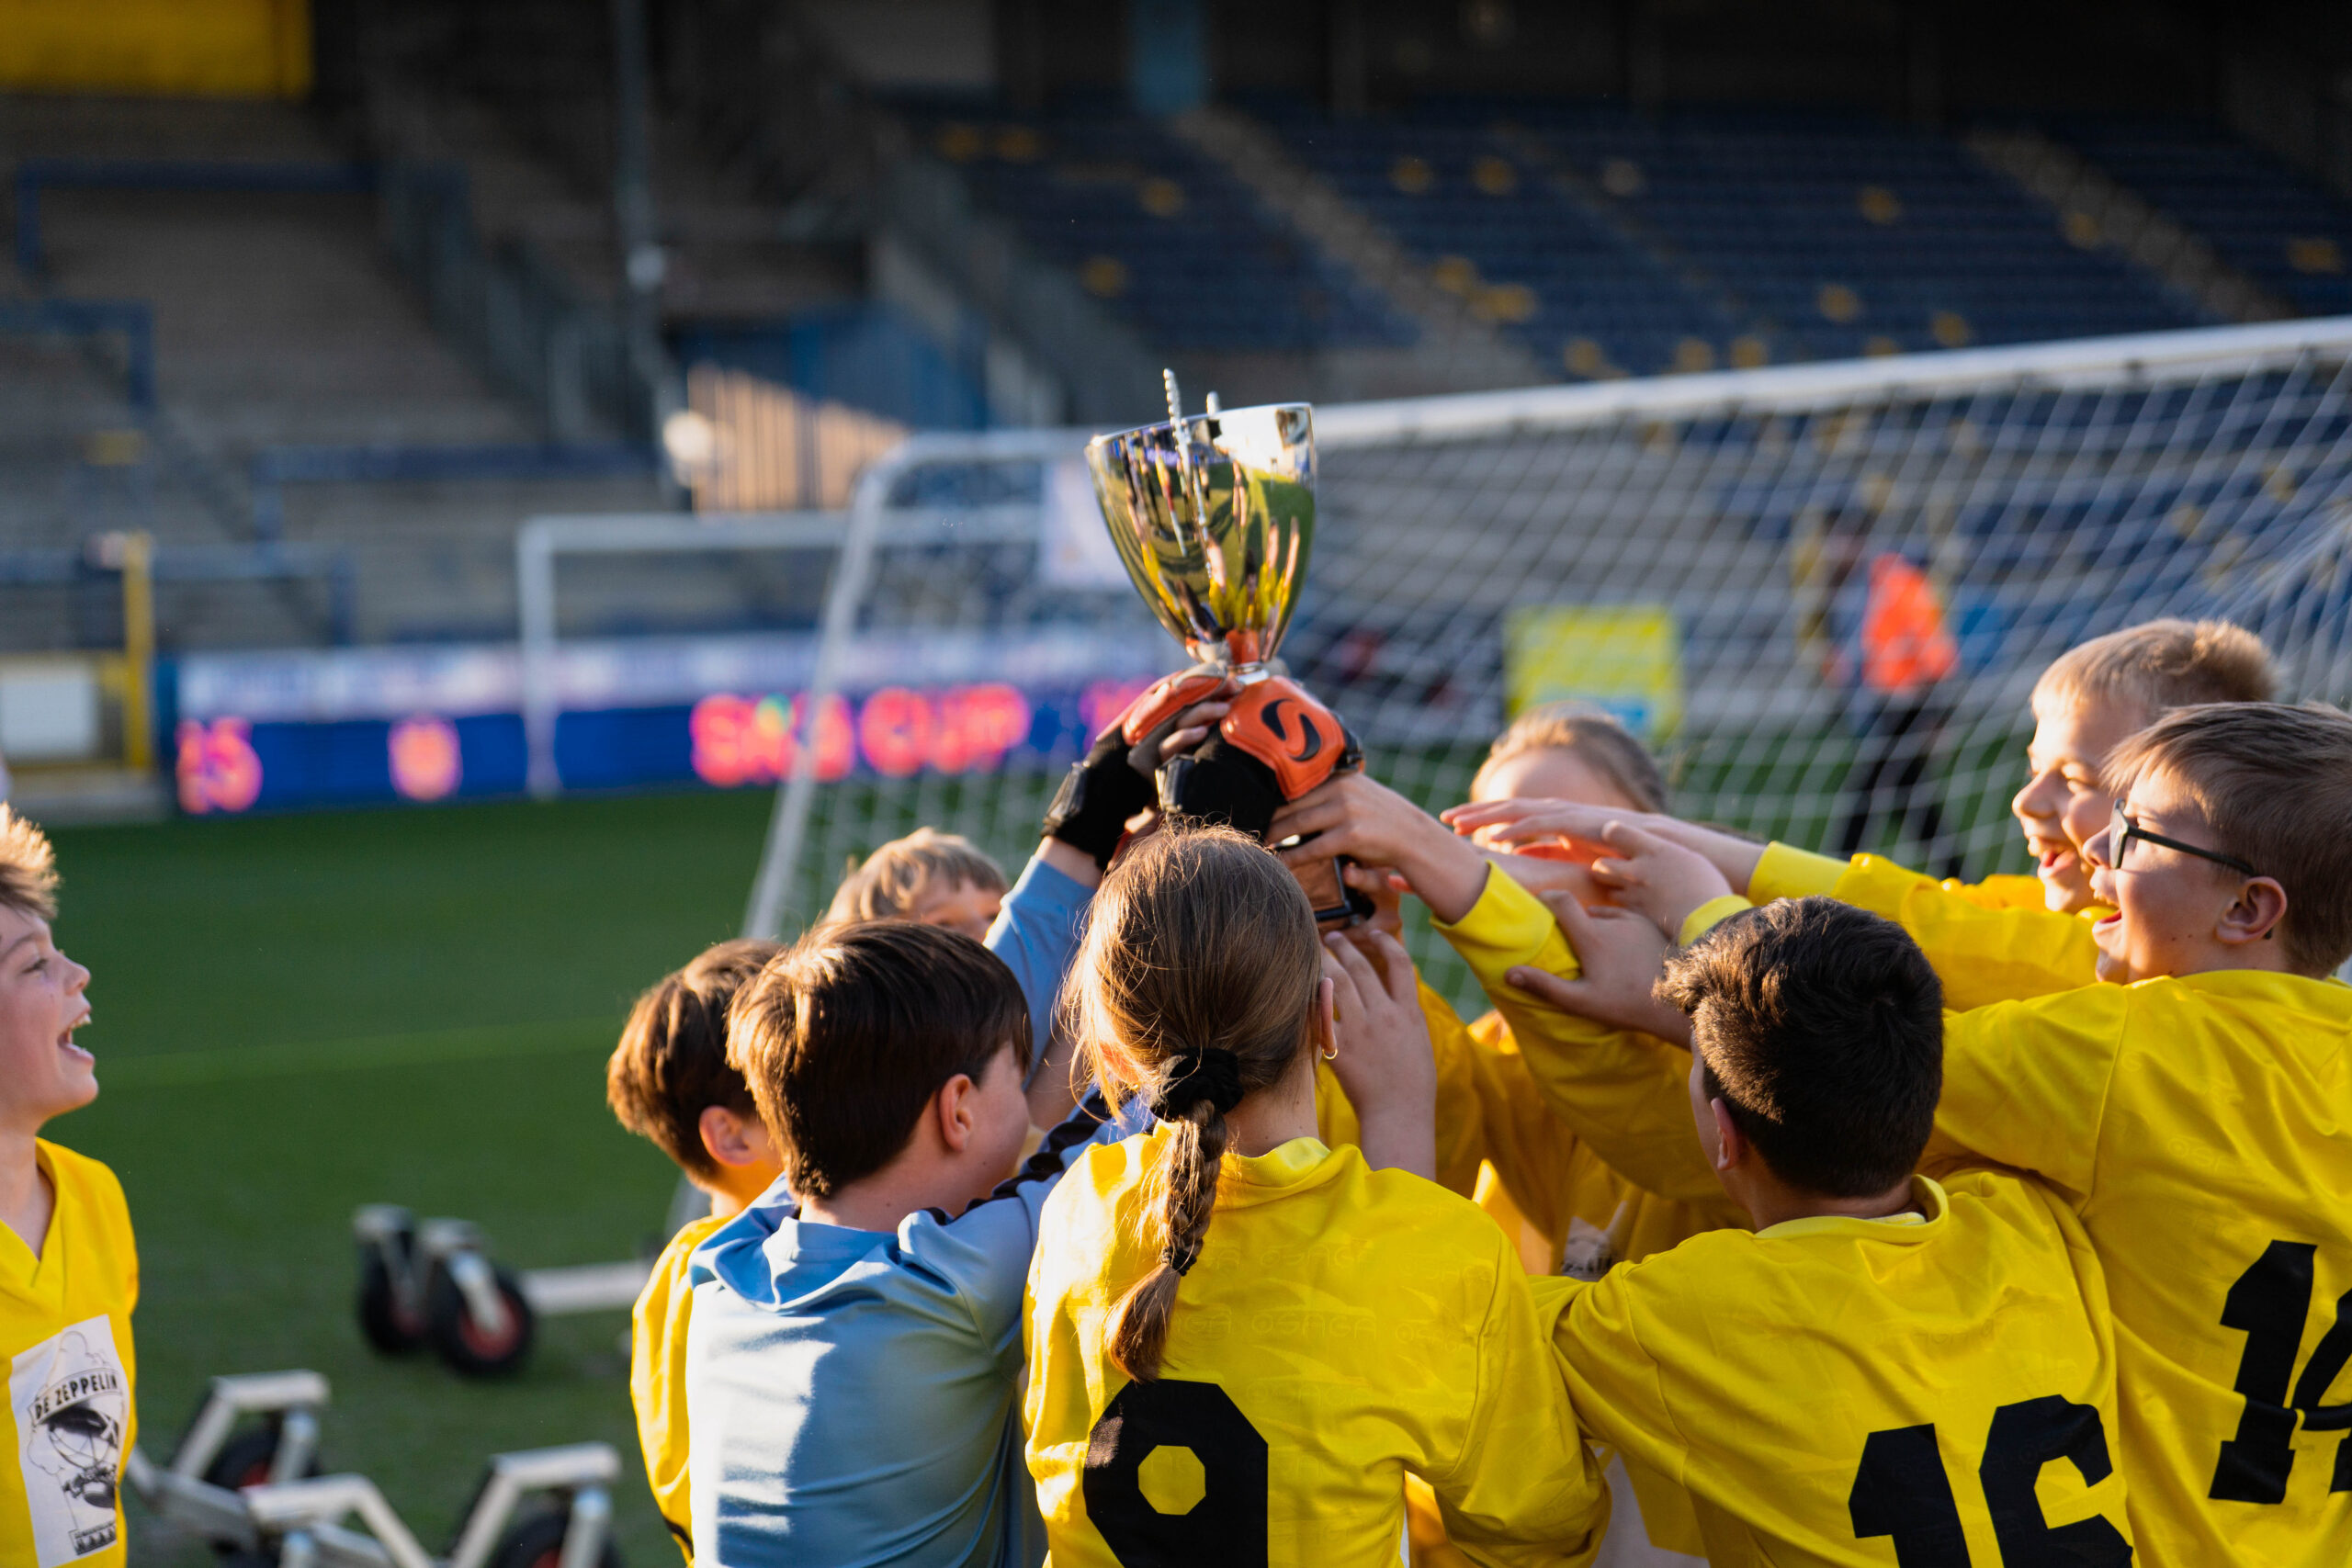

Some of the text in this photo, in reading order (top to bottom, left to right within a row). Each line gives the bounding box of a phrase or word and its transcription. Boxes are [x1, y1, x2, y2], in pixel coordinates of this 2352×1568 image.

[36, 1373, 118, 1419] DE ZEPPELIN
[1849, 1393, 2133, 1568] 16
